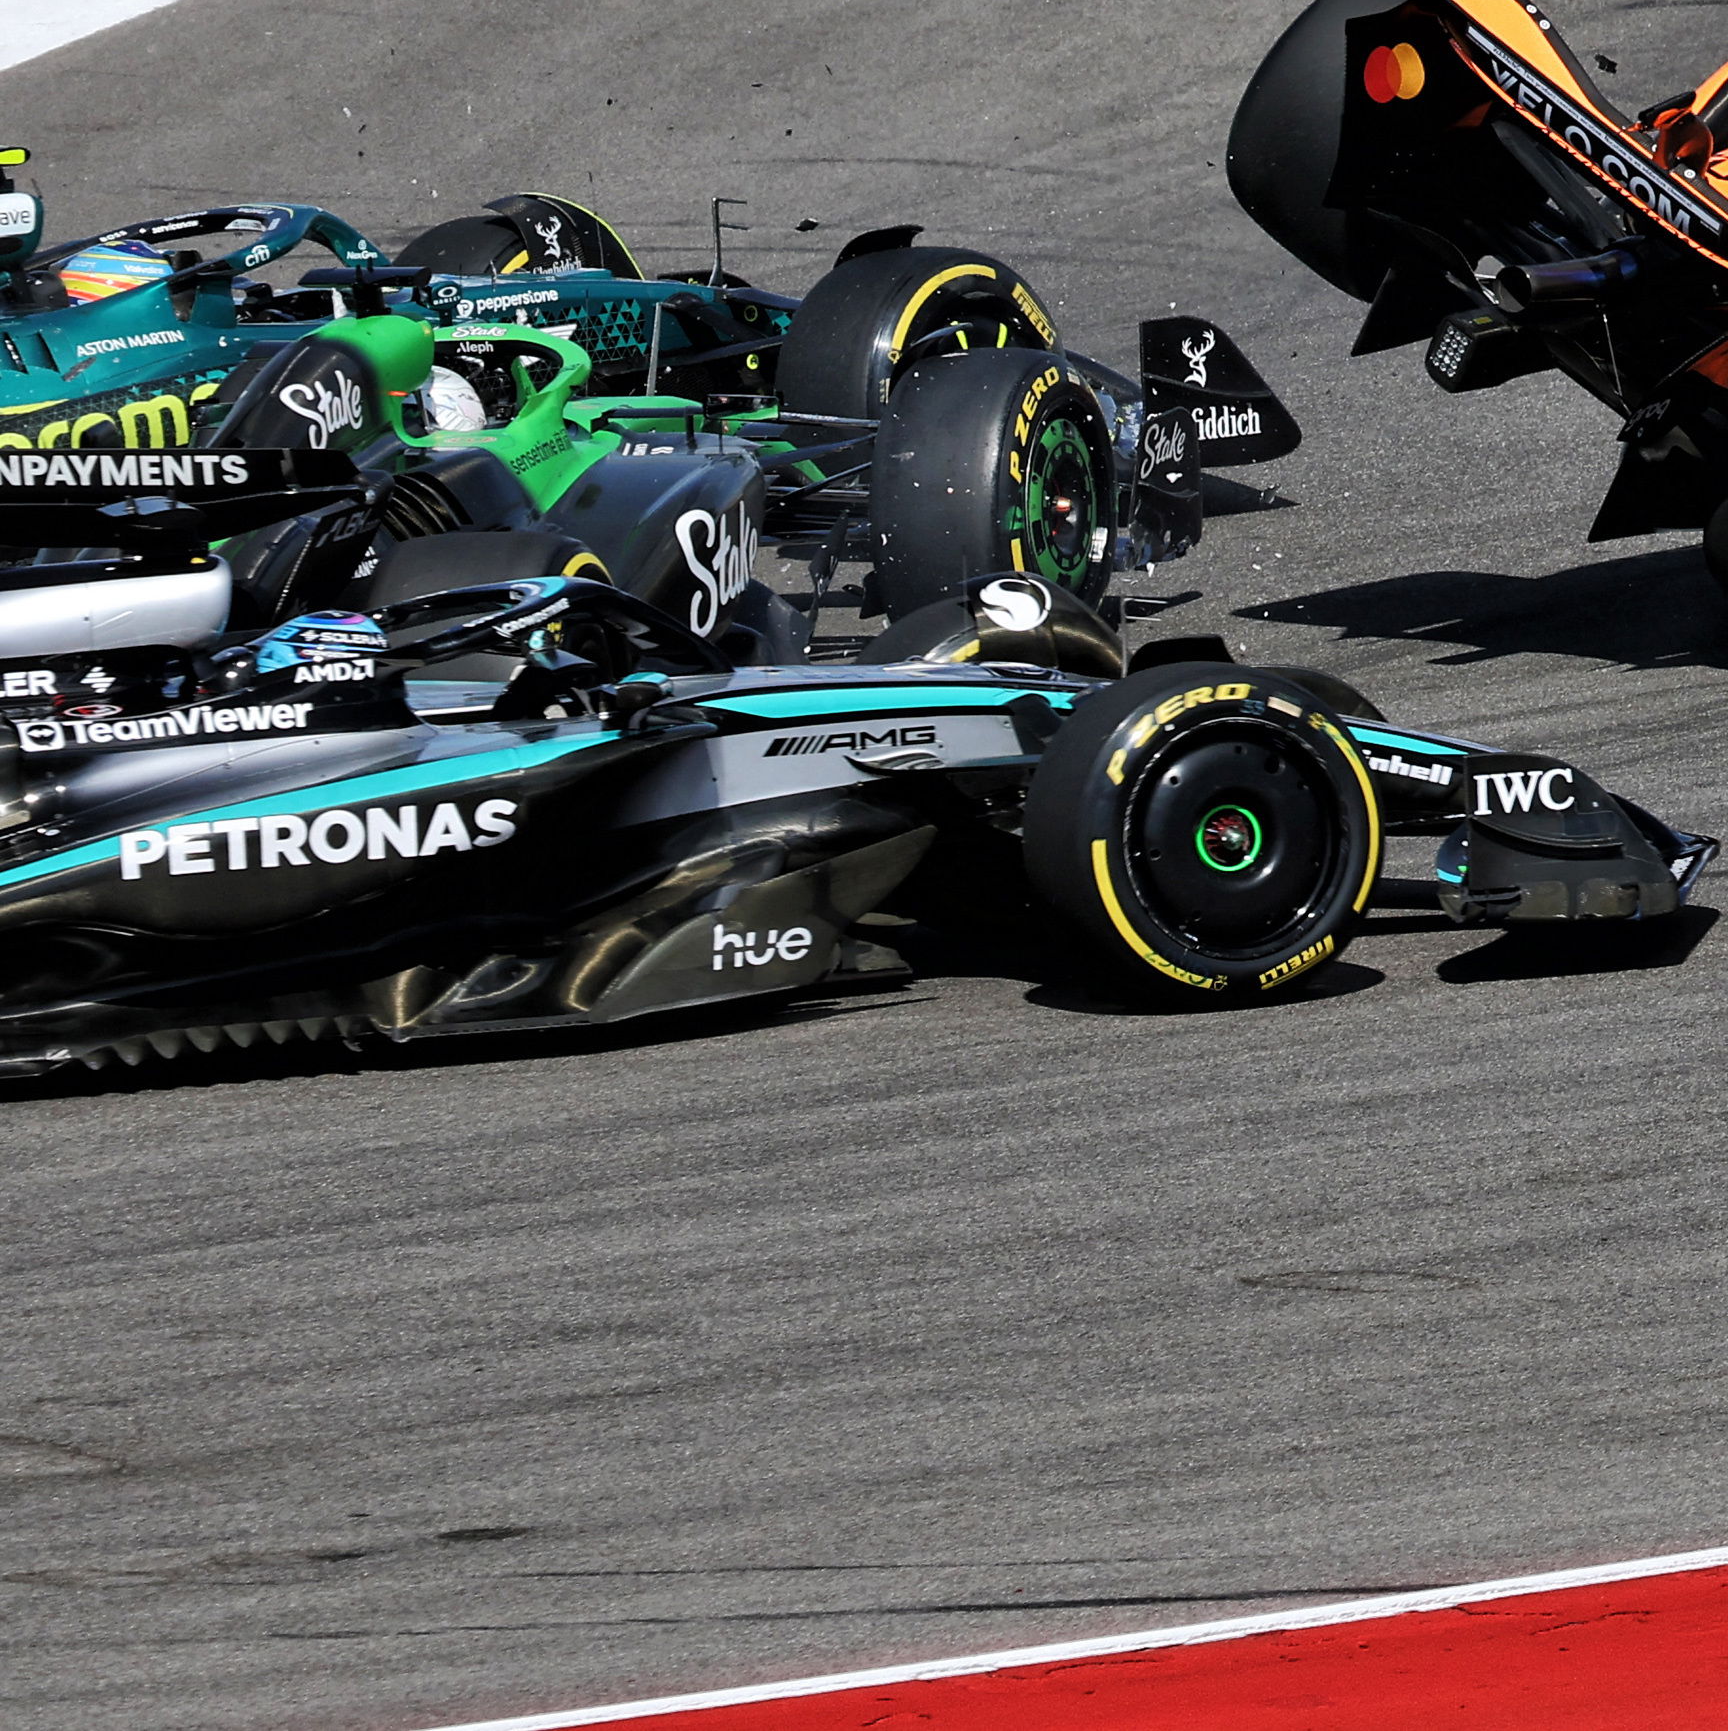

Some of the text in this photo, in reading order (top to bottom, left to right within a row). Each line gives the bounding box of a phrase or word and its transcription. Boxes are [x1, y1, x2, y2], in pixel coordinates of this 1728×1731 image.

[245, 245, 271, 268] citi
[475, 288, 560, 315] pepperstone
[76, 330, 186, 358] ASTON MARTIN
[452, 325, 508, 339] Stake
[456, 341, 494, 355] Aleph
[279, 369, 364, 450] Stake
[1009, 366, 1061, 484] P ZERO
[510, 437, 557, 476] sensetime
[1140, 421, 1187, 480] Stake
[675, 500, 759, 639] Stake
[294, 659, 364, 684] AMD
[66, 703, 314, 745] TeamViewer
[1130, 682, 1252, 749] ZERO
[818, 725, 937, 754] AMG
[1472, 767, 1576, 817] IWC
[121, 798, 518, 881] PETRONAS
[712, 923, 815, 973] hue
[1258, 933, 1335, 990] PIRELLI
